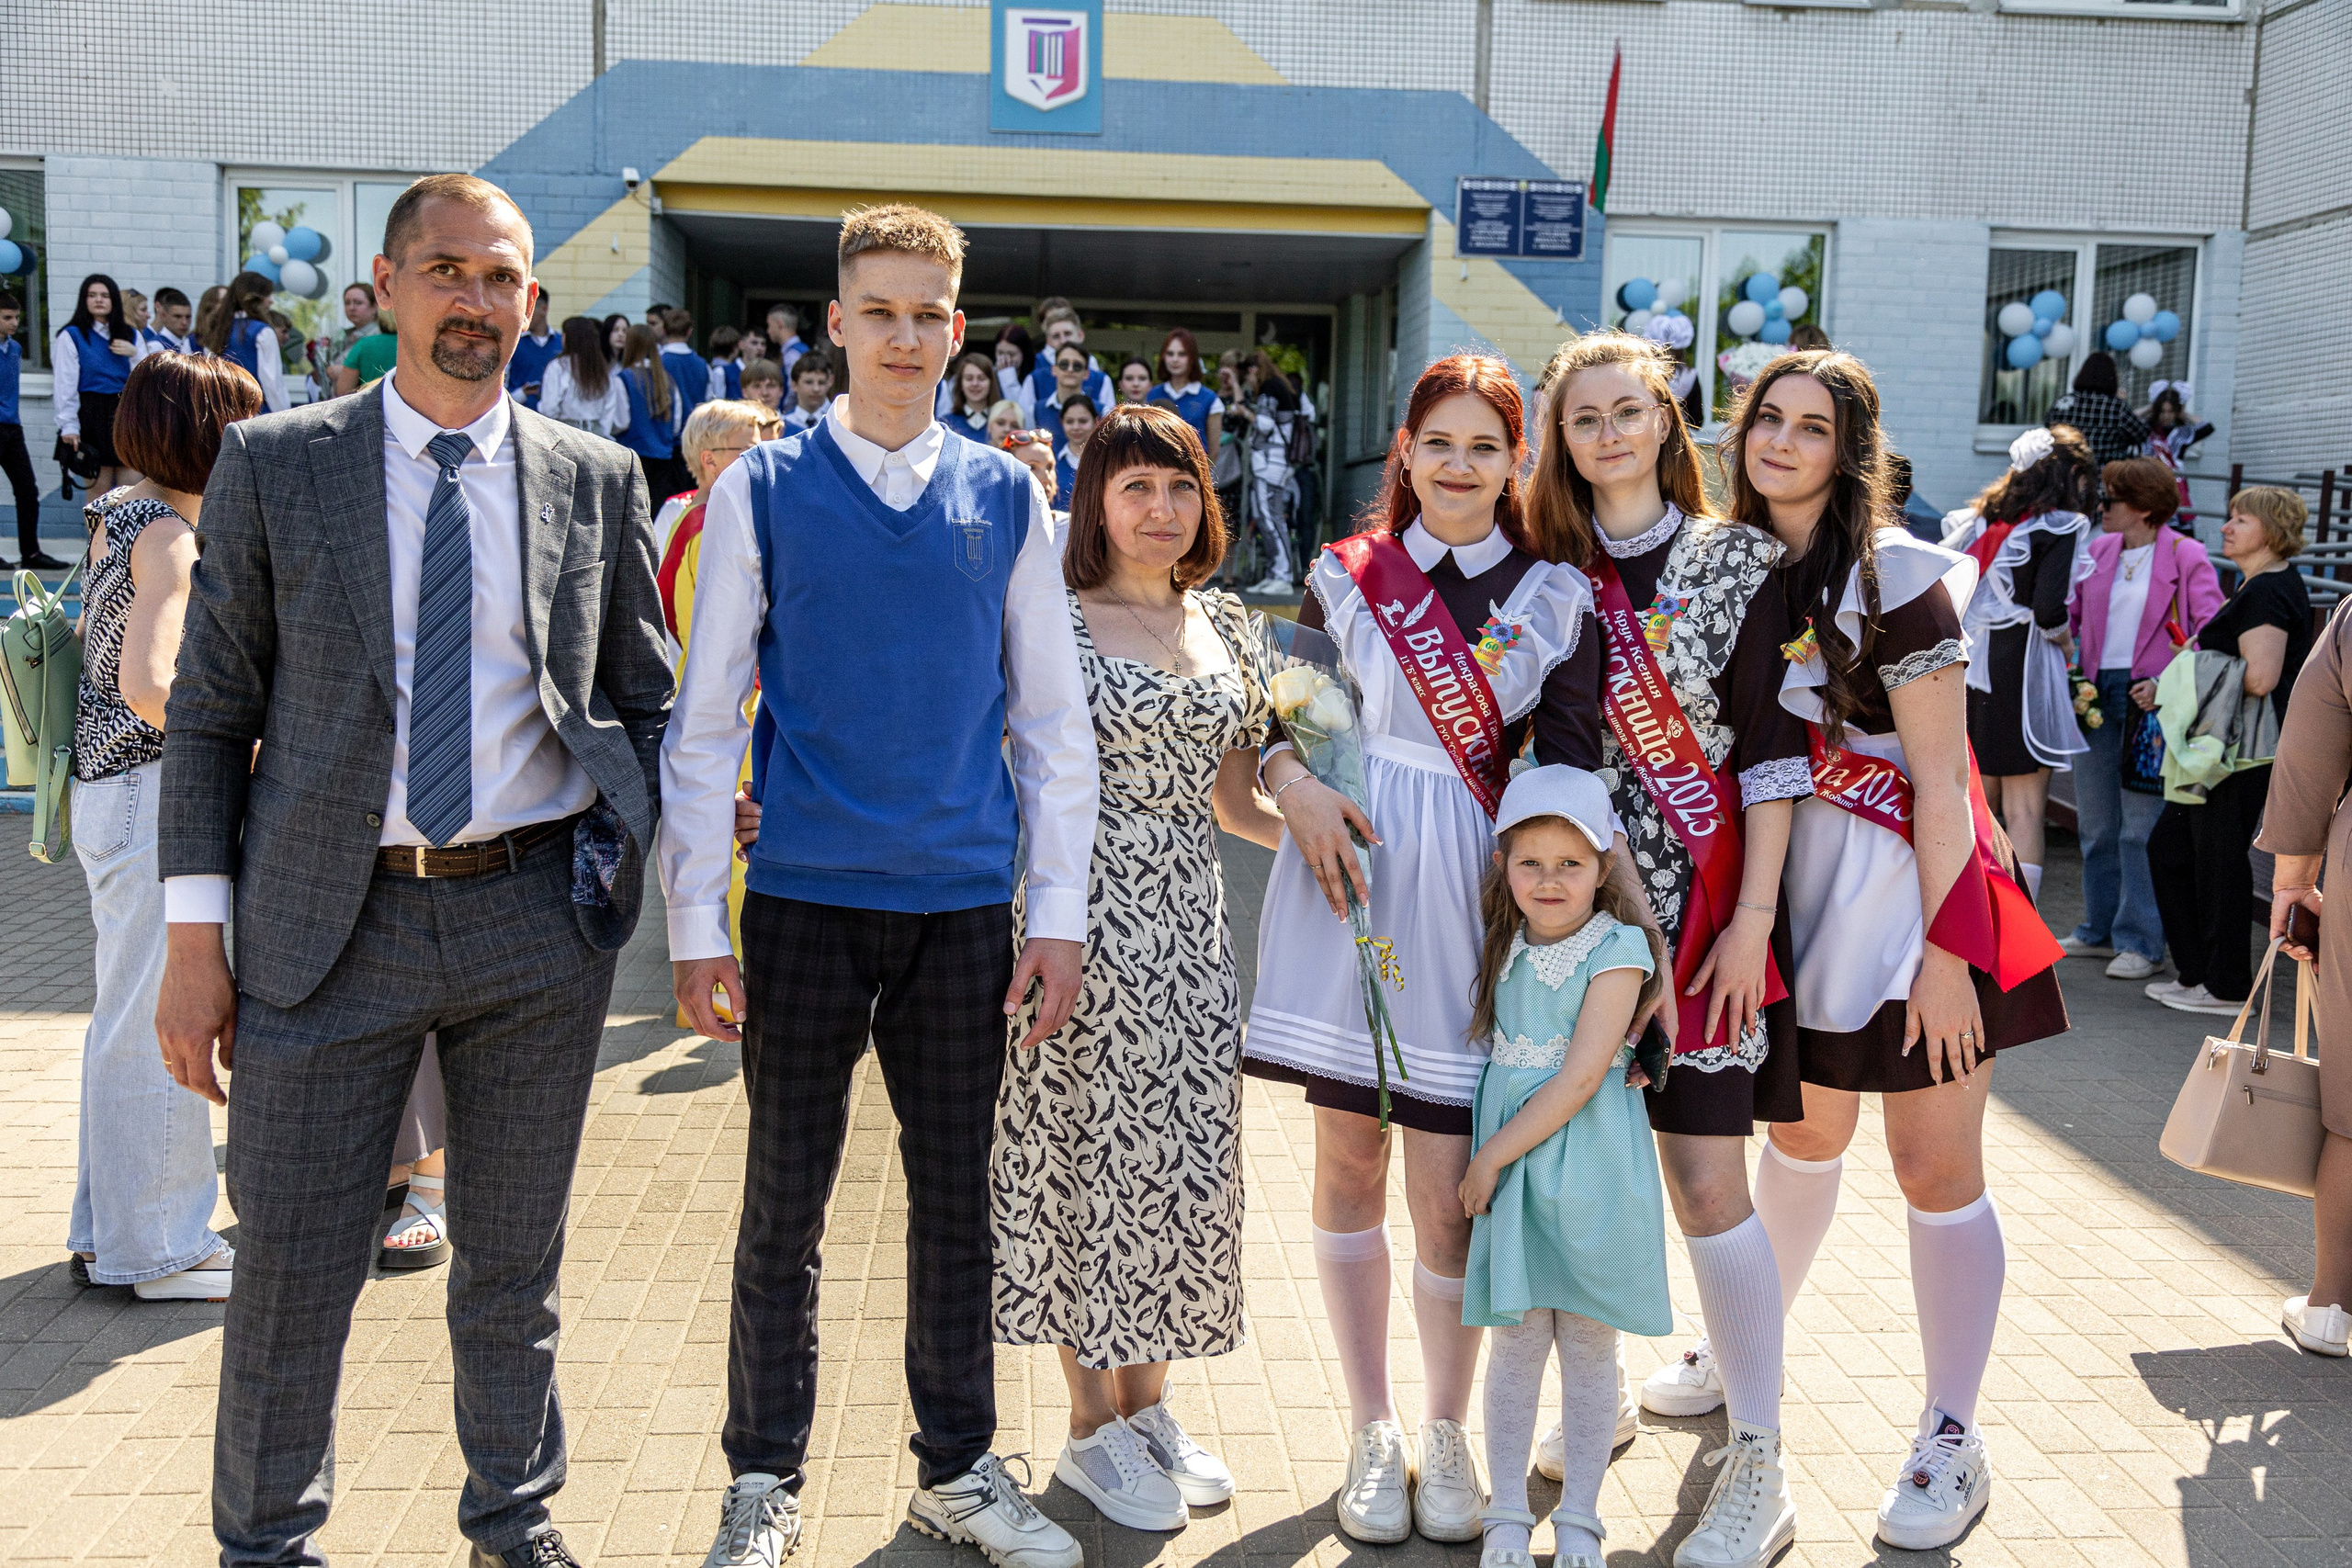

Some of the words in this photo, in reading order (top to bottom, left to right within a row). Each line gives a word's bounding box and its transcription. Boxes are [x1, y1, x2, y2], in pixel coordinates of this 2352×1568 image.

[1654, 617, 1667, 628] 60
[1485, 641, 1499, 652] 60
[1613, 609, 1634, 643] Крук
[1629, 645, 1662, 699] Ксения
[1399, 655, 1410, 665] 11
[1406, 664, 1417, 675] "Б"
[1410, 676, 1426, 698] класс
[1452, 651, 1492, 717] Некрасова
[1405, 626, 1501, 803] Выпускни
[1590, 575, 1676, 772] Впскница
[1654, 761, 1726, 837] 2023
[1436, 724, 1451, 741] ГУО
[1448, 741, 1469, 778] "Средняя
[1466, 777, 1486, 801] школа
[1610, 716, 1628, 742] школа
[1624, 742, 1637, 756] №8
[1636, 764, 1663, 797] Жодино"
[1819, 788, 1858, 809] Жодино"
[1963, 1481, 1973, 1502] adidas
